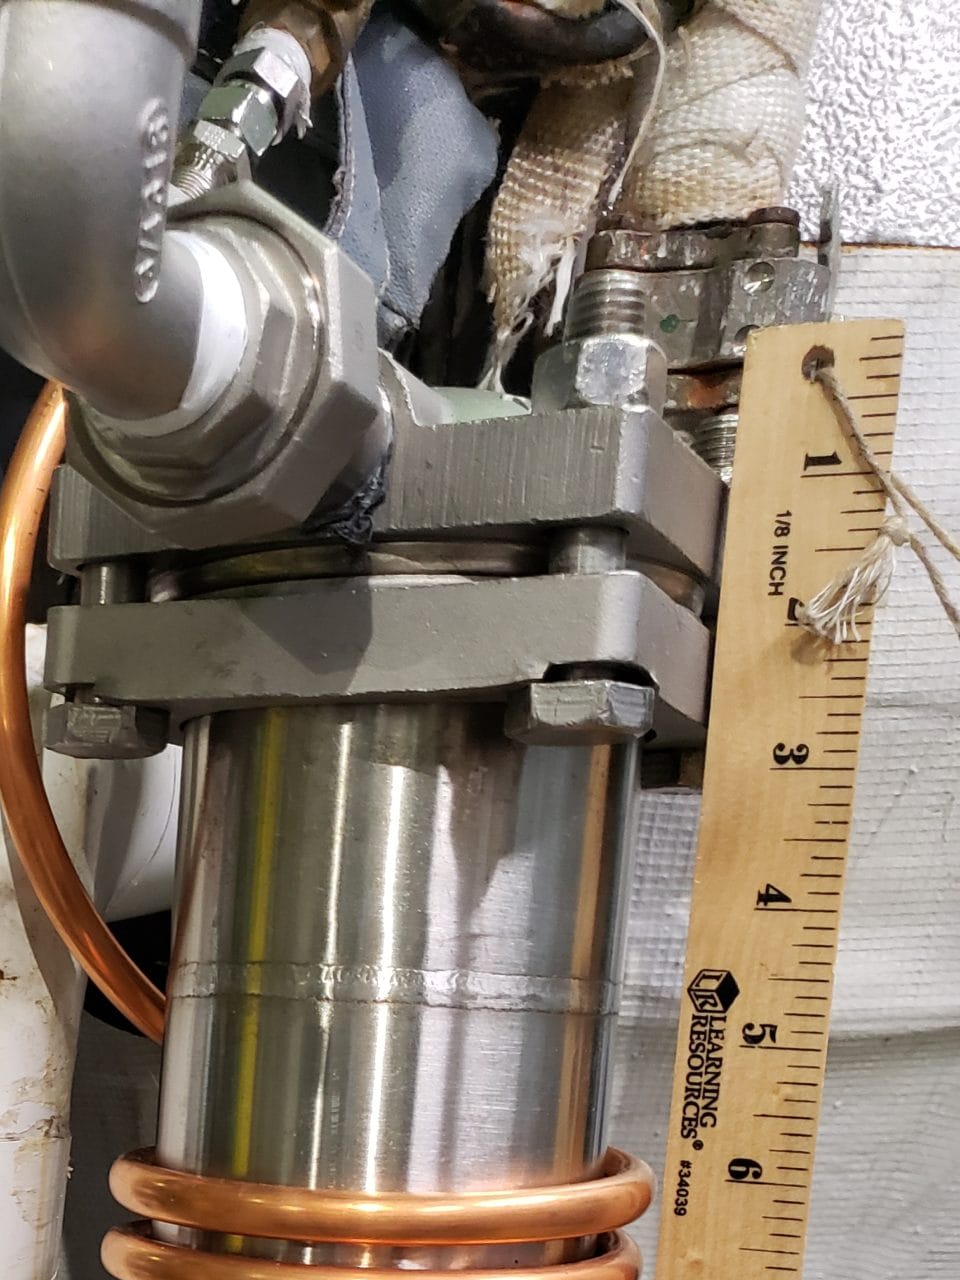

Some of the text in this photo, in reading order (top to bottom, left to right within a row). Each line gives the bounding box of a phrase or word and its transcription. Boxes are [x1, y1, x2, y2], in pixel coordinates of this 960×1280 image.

[804, 452, 841, 471] 1
[767, 510, 792, 597] 1/8 INCH
[773, 742, 809, 765] 3
[756, 883, 792, 906] 4
[742, 1022, 778, 1045] 5
[699, 1014, 728, 1129] LEARNING
[727, 1157, 763, 1180] 6
[674, 1160, 693, 1217] #34039
